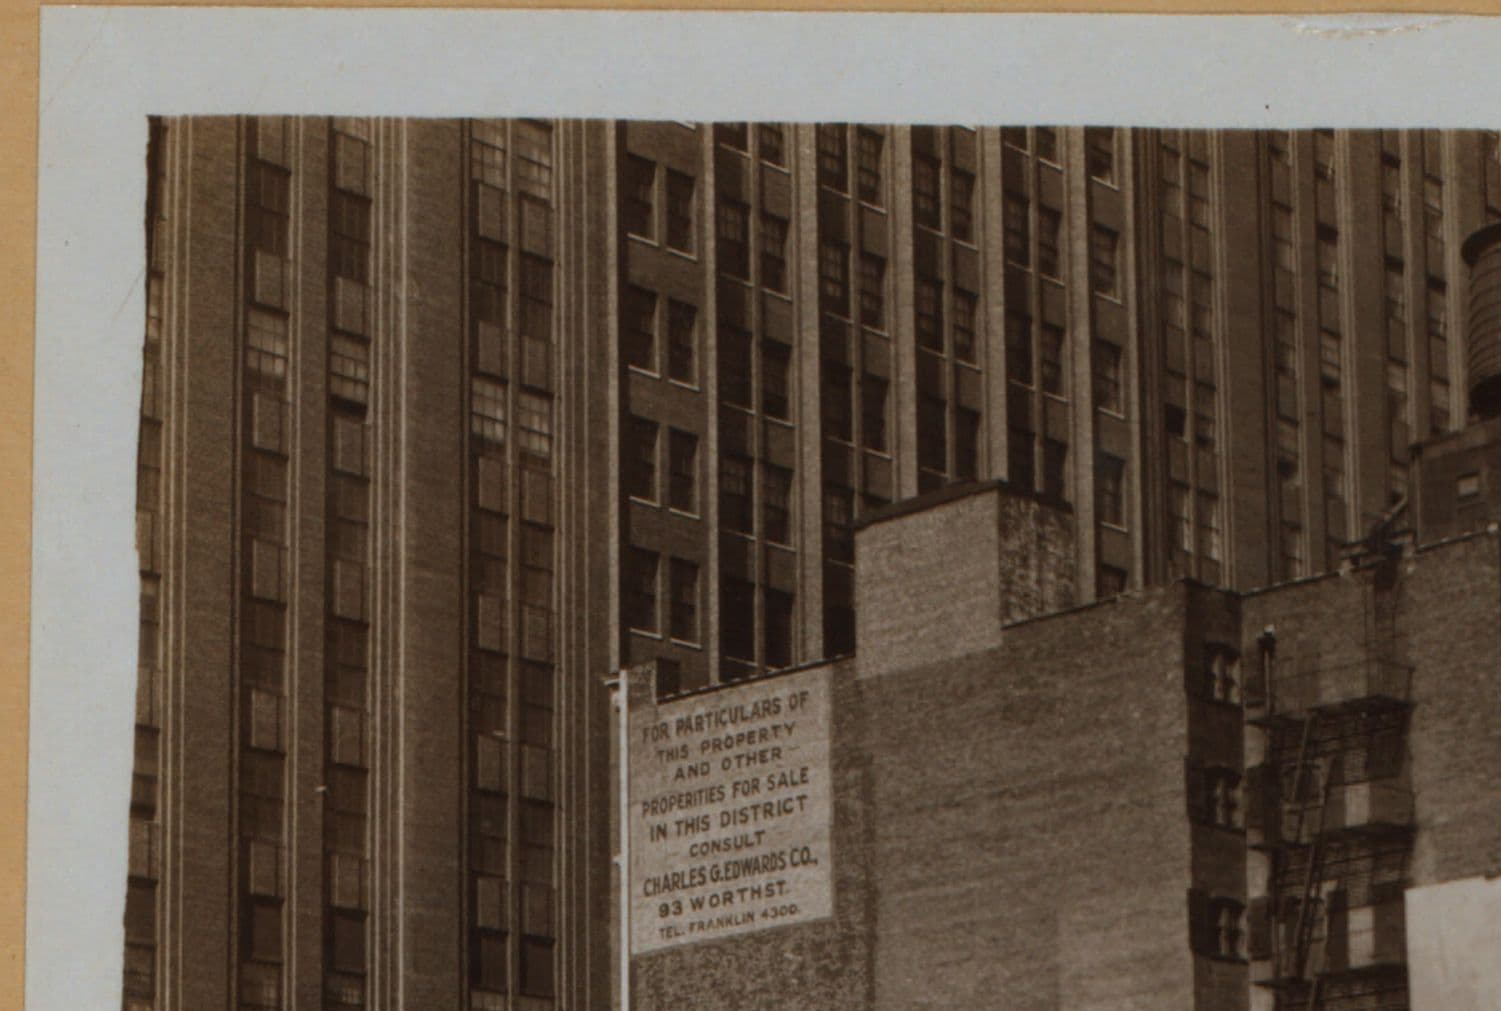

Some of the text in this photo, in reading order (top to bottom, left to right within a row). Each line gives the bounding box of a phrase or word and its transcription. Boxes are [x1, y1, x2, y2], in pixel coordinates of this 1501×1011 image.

[643, 691, 809, 745] FOR PARTICULARS OF
[657, 721, 797, 765] THIS PROPERTY
[674, 746, 782, 781] AND OTHER
[732, 777, 760, 799] FOR
[767, 766, 809, 792] SALE
[649, 794, 808, 842] IN THIS DISTRICT
[689, 830, 766, 857] CONSULT
[643, 867, 706, 897] CHARLES
[659, 900, 683, 919] 93
[689, 911, 755, 933] FRANKLIN
